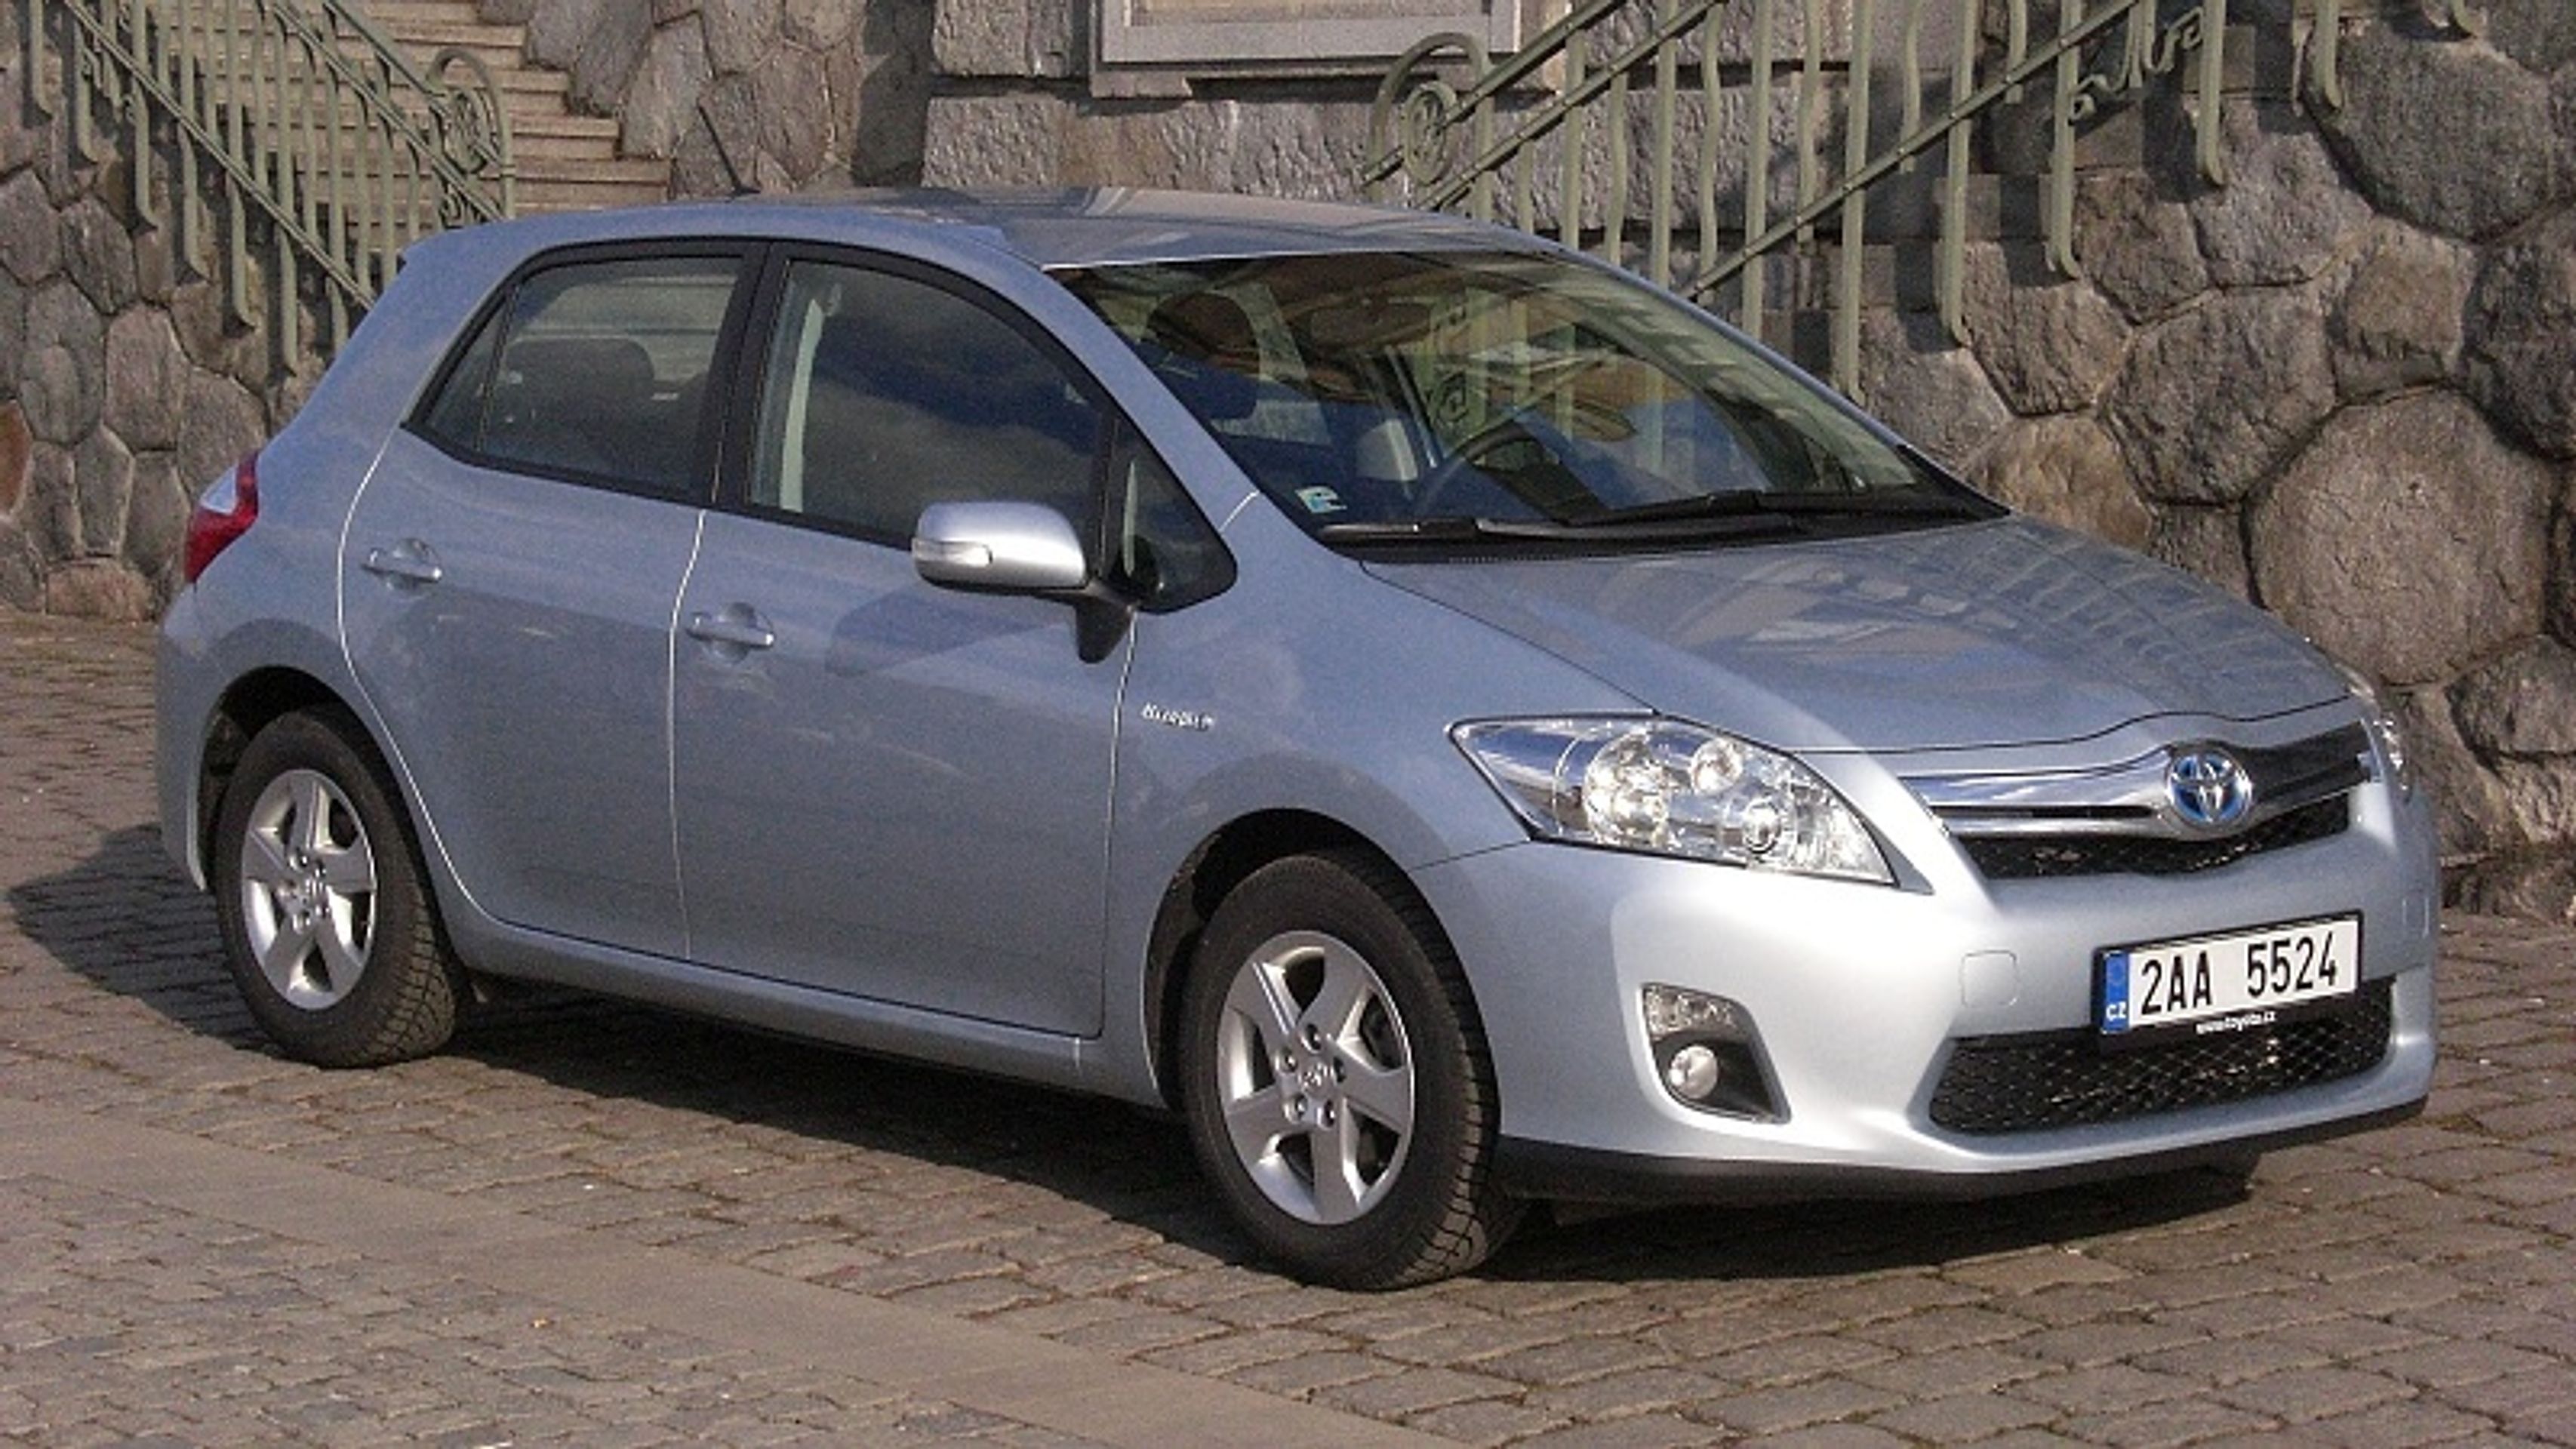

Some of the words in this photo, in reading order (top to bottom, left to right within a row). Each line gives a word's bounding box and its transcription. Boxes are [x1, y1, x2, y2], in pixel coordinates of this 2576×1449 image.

[2141, 950, 2213, 1016] 2AA
[2246, 931, 2337, 998] 5524
[2106, 1001, 2126, 1021] CZ
